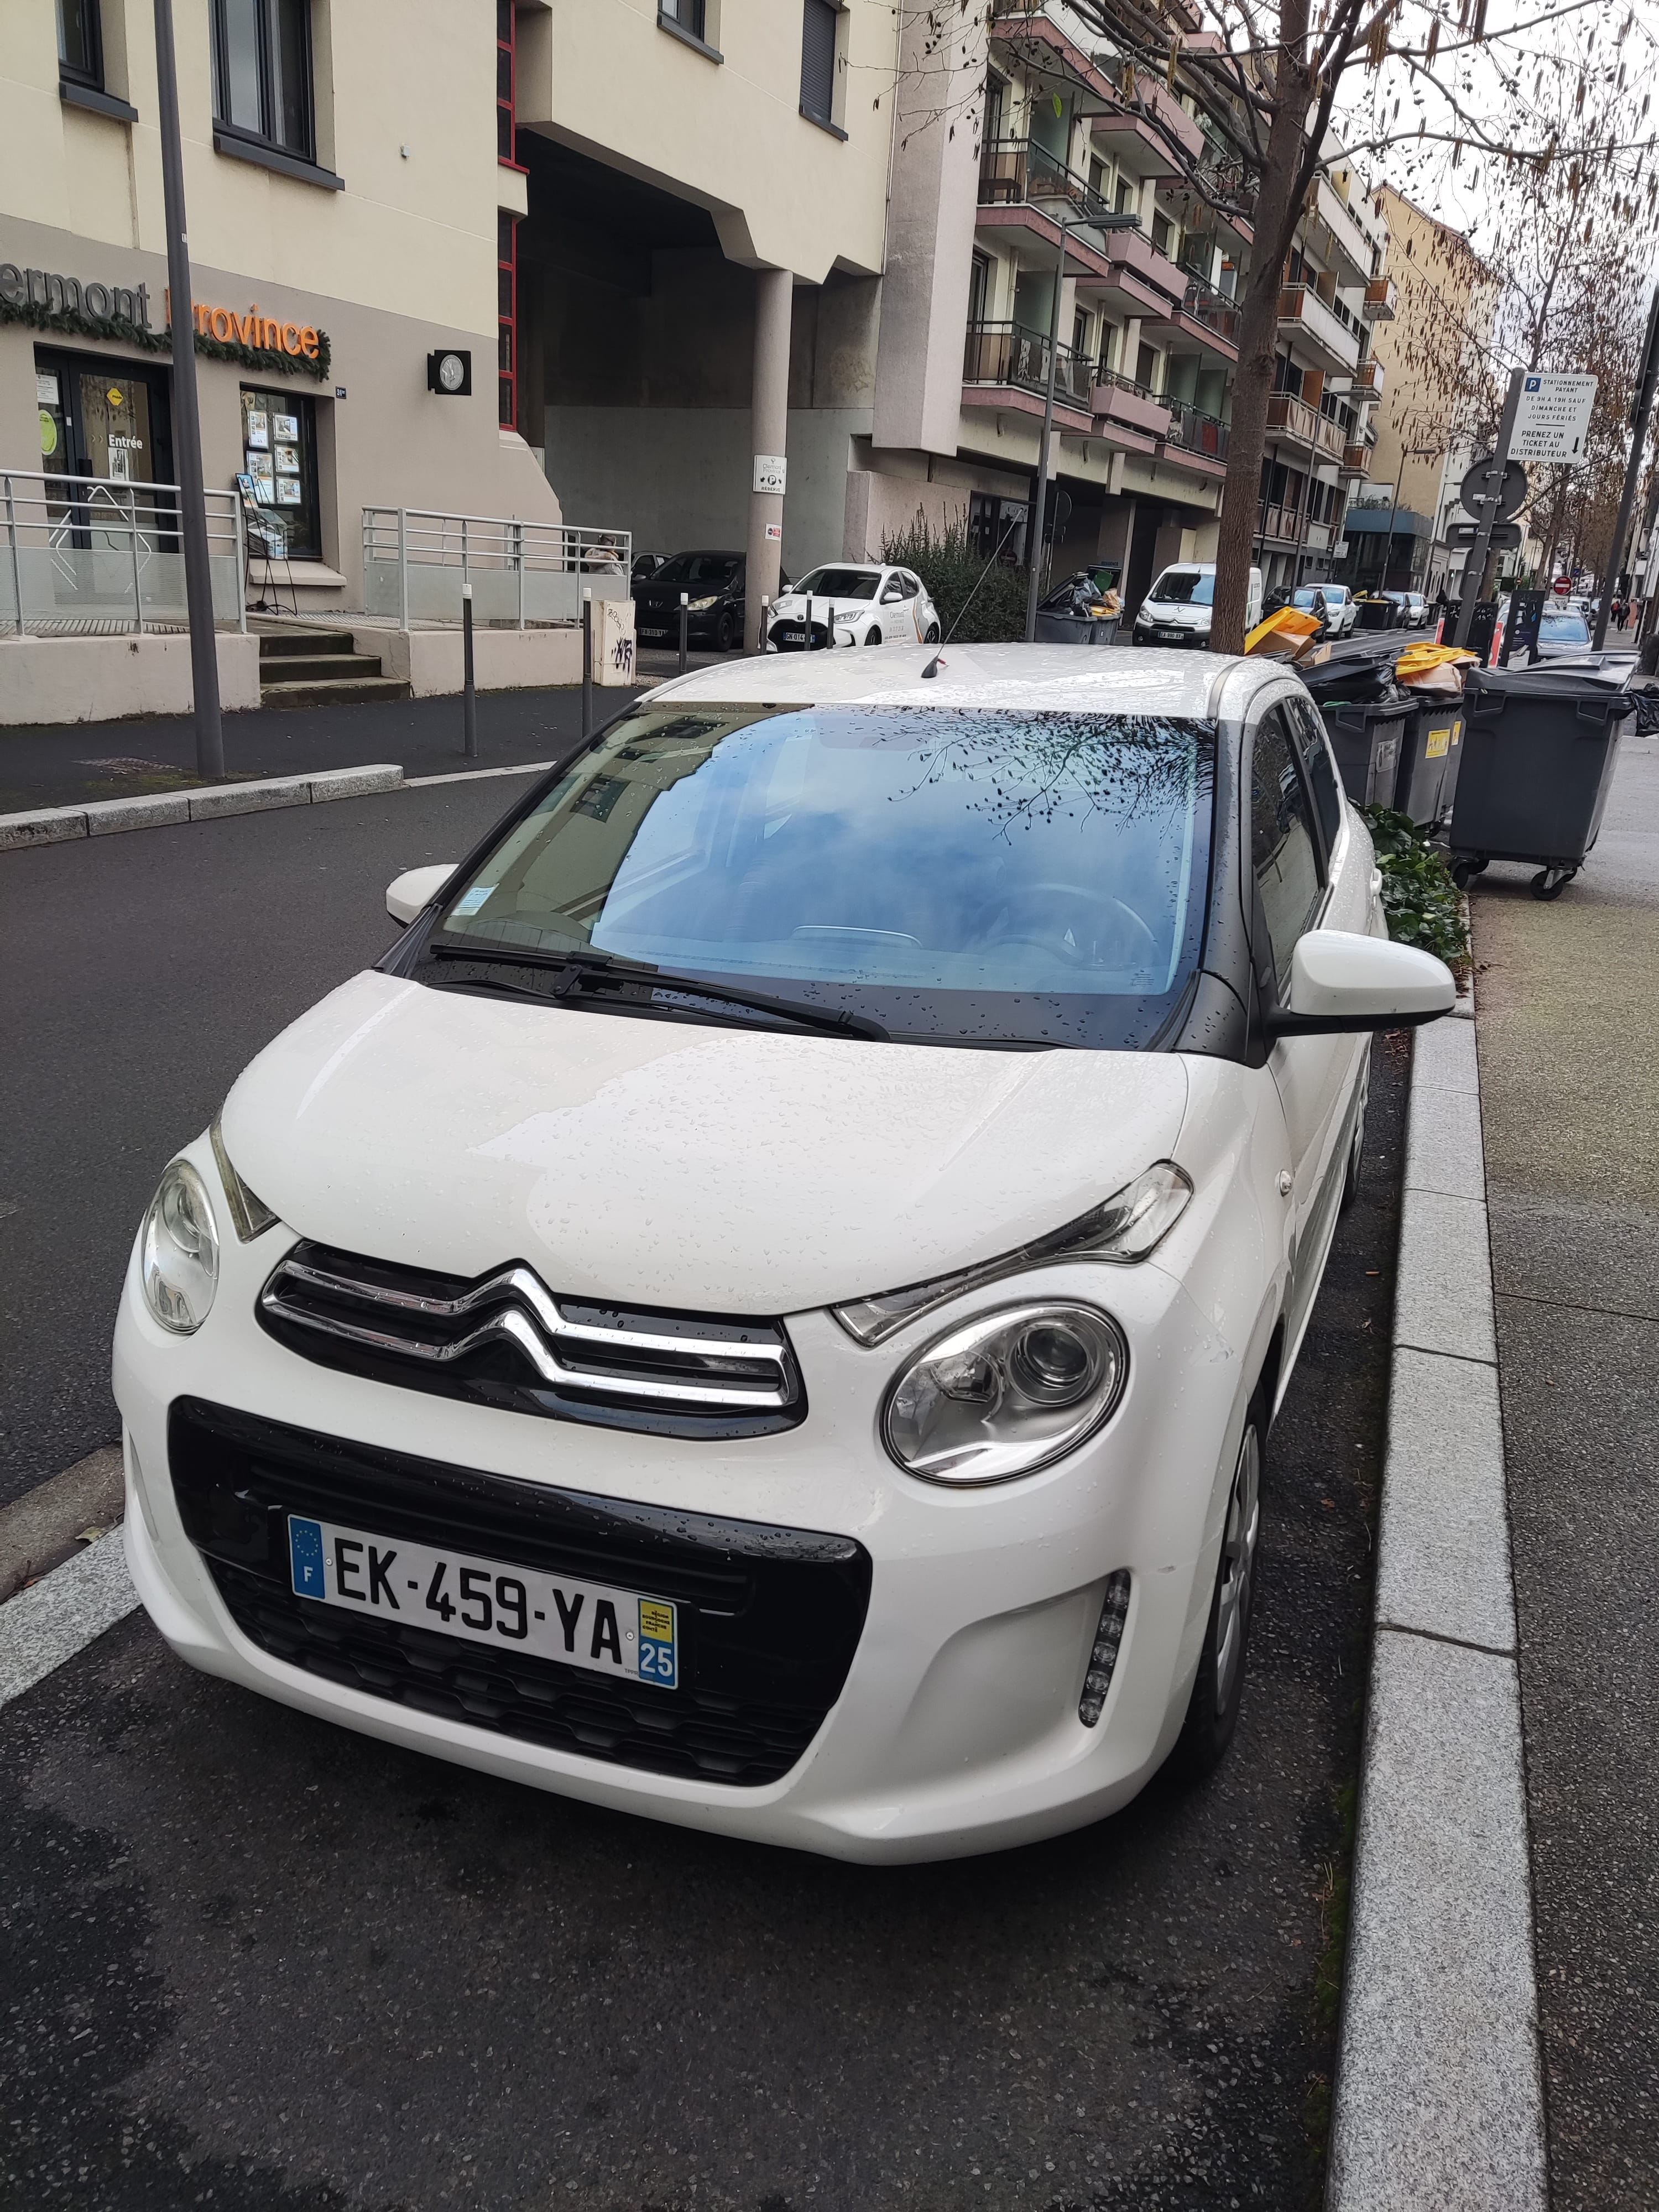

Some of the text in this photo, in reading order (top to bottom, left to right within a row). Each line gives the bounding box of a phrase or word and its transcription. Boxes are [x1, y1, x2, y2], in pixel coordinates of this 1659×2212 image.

[164, 287, 319, 359] rovince
[1528, 380, 1537, 390] P
[108, 434, 143, 450] Entrée
[1522, 439, 1547, 447] TICKET
[1511, 448, 1567, 458] DISTRIBUTEUR
[304, 1567, 313, 1582] F
[335, 1537, 622, 1665] EK-459-YA
[640, 1642, 673, 1677] 25
